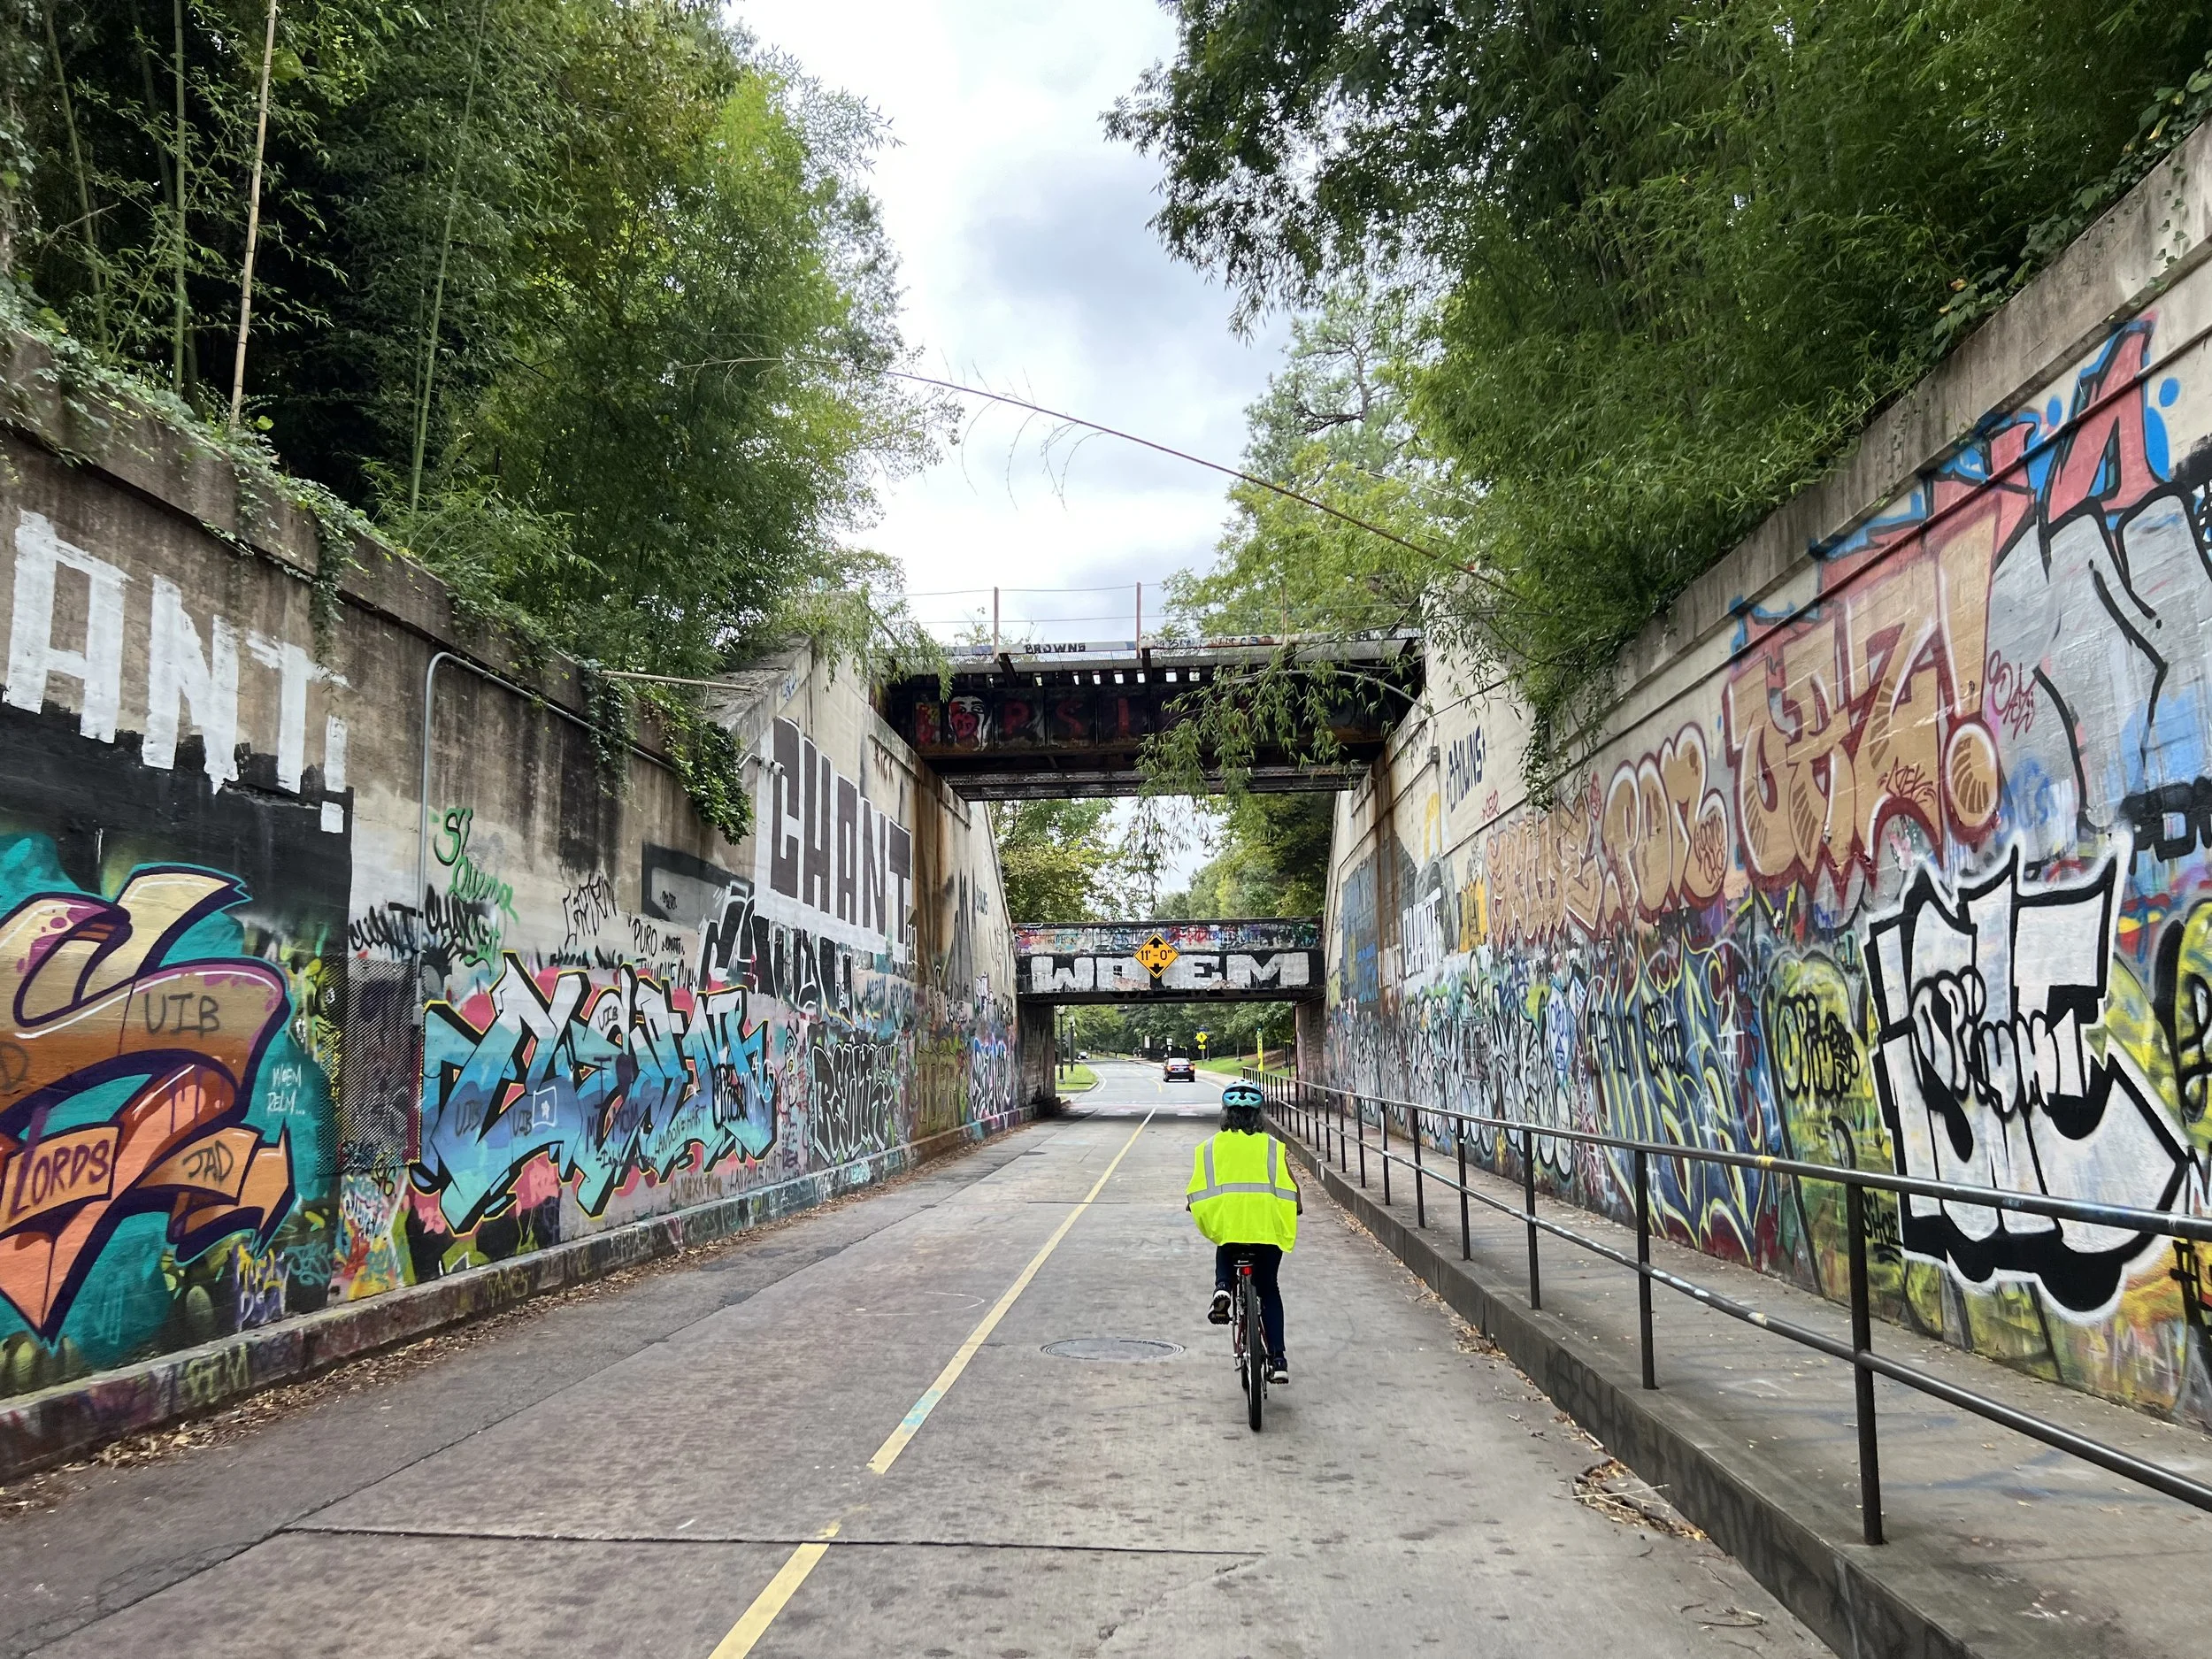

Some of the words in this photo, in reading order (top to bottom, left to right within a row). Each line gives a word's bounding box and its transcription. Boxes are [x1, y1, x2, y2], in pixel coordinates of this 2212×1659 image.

[770, 716, 912, 947] CHANT
[631, 918, 658, 958] PURO
[144, 992, 220, 1039] UIB
[597, 1005, 618, 1032] UIB
[9, 1106, 111, 1221] LORDS
